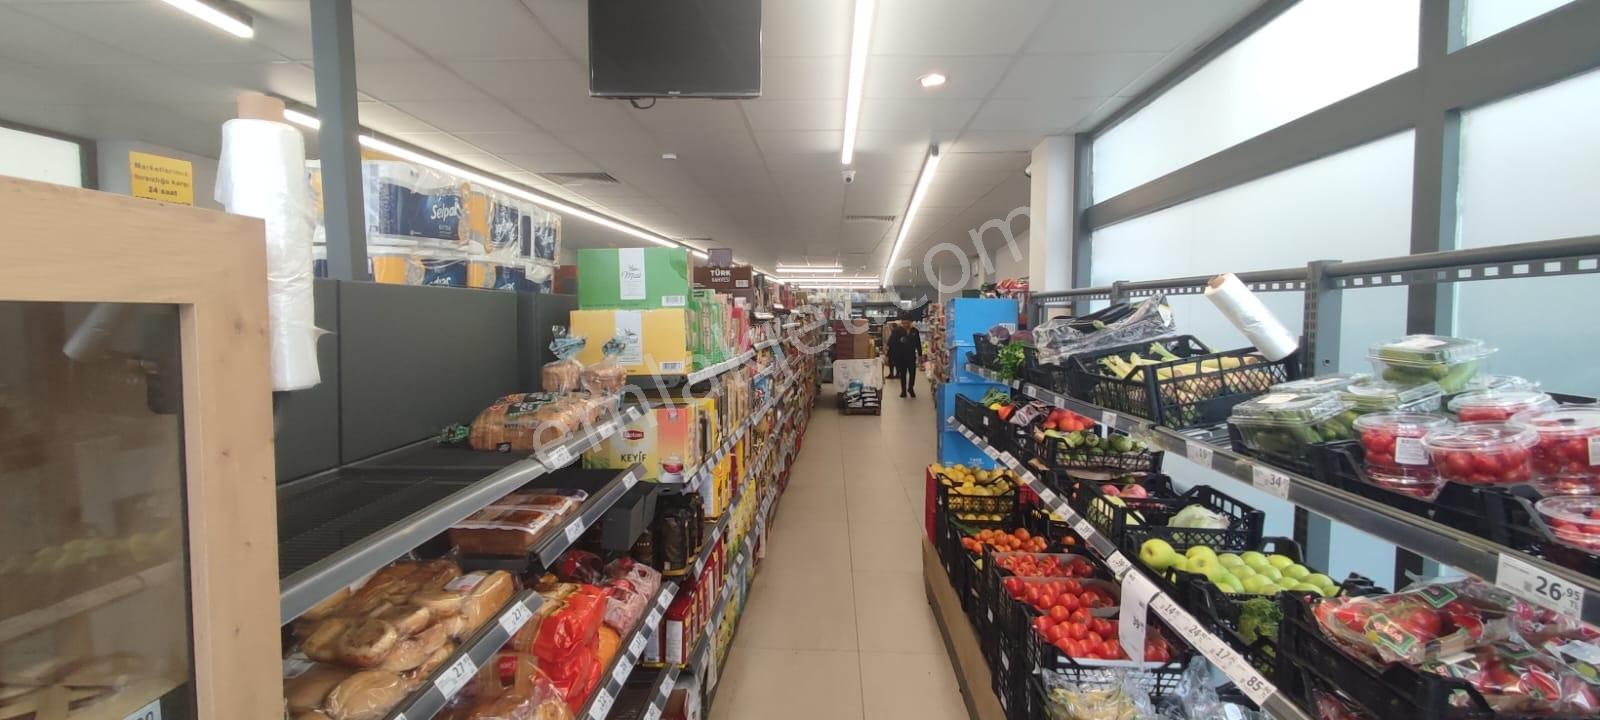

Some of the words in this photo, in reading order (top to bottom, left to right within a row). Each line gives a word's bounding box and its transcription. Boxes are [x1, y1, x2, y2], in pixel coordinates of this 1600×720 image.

[710, 268, 731, 277] TÜRK
[620, 451, 647, 463] KEYİF
[1246, 675, 1264, 692] 85
